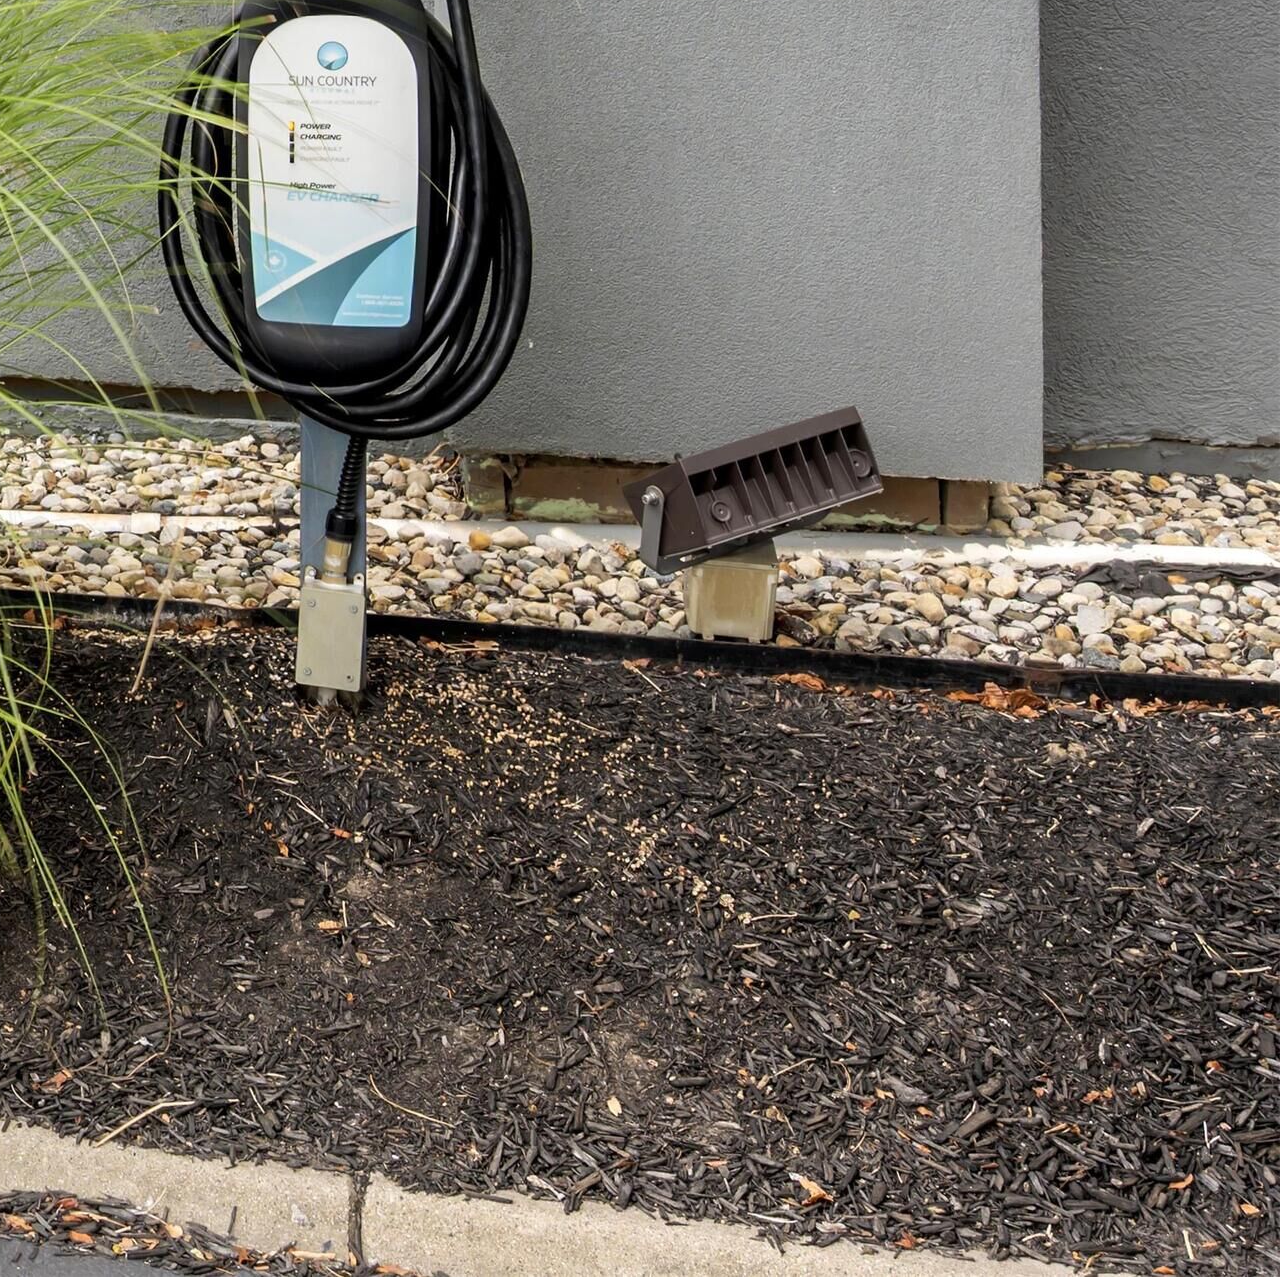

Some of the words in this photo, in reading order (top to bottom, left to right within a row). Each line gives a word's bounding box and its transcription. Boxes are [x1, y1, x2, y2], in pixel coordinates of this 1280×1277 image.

[288, 75, 314, 86] SUN
[317, 75, 377, 87] COUNTRY
[287, 191, 306, 201] EV
[310, 192, 380, 204] CHARGER
